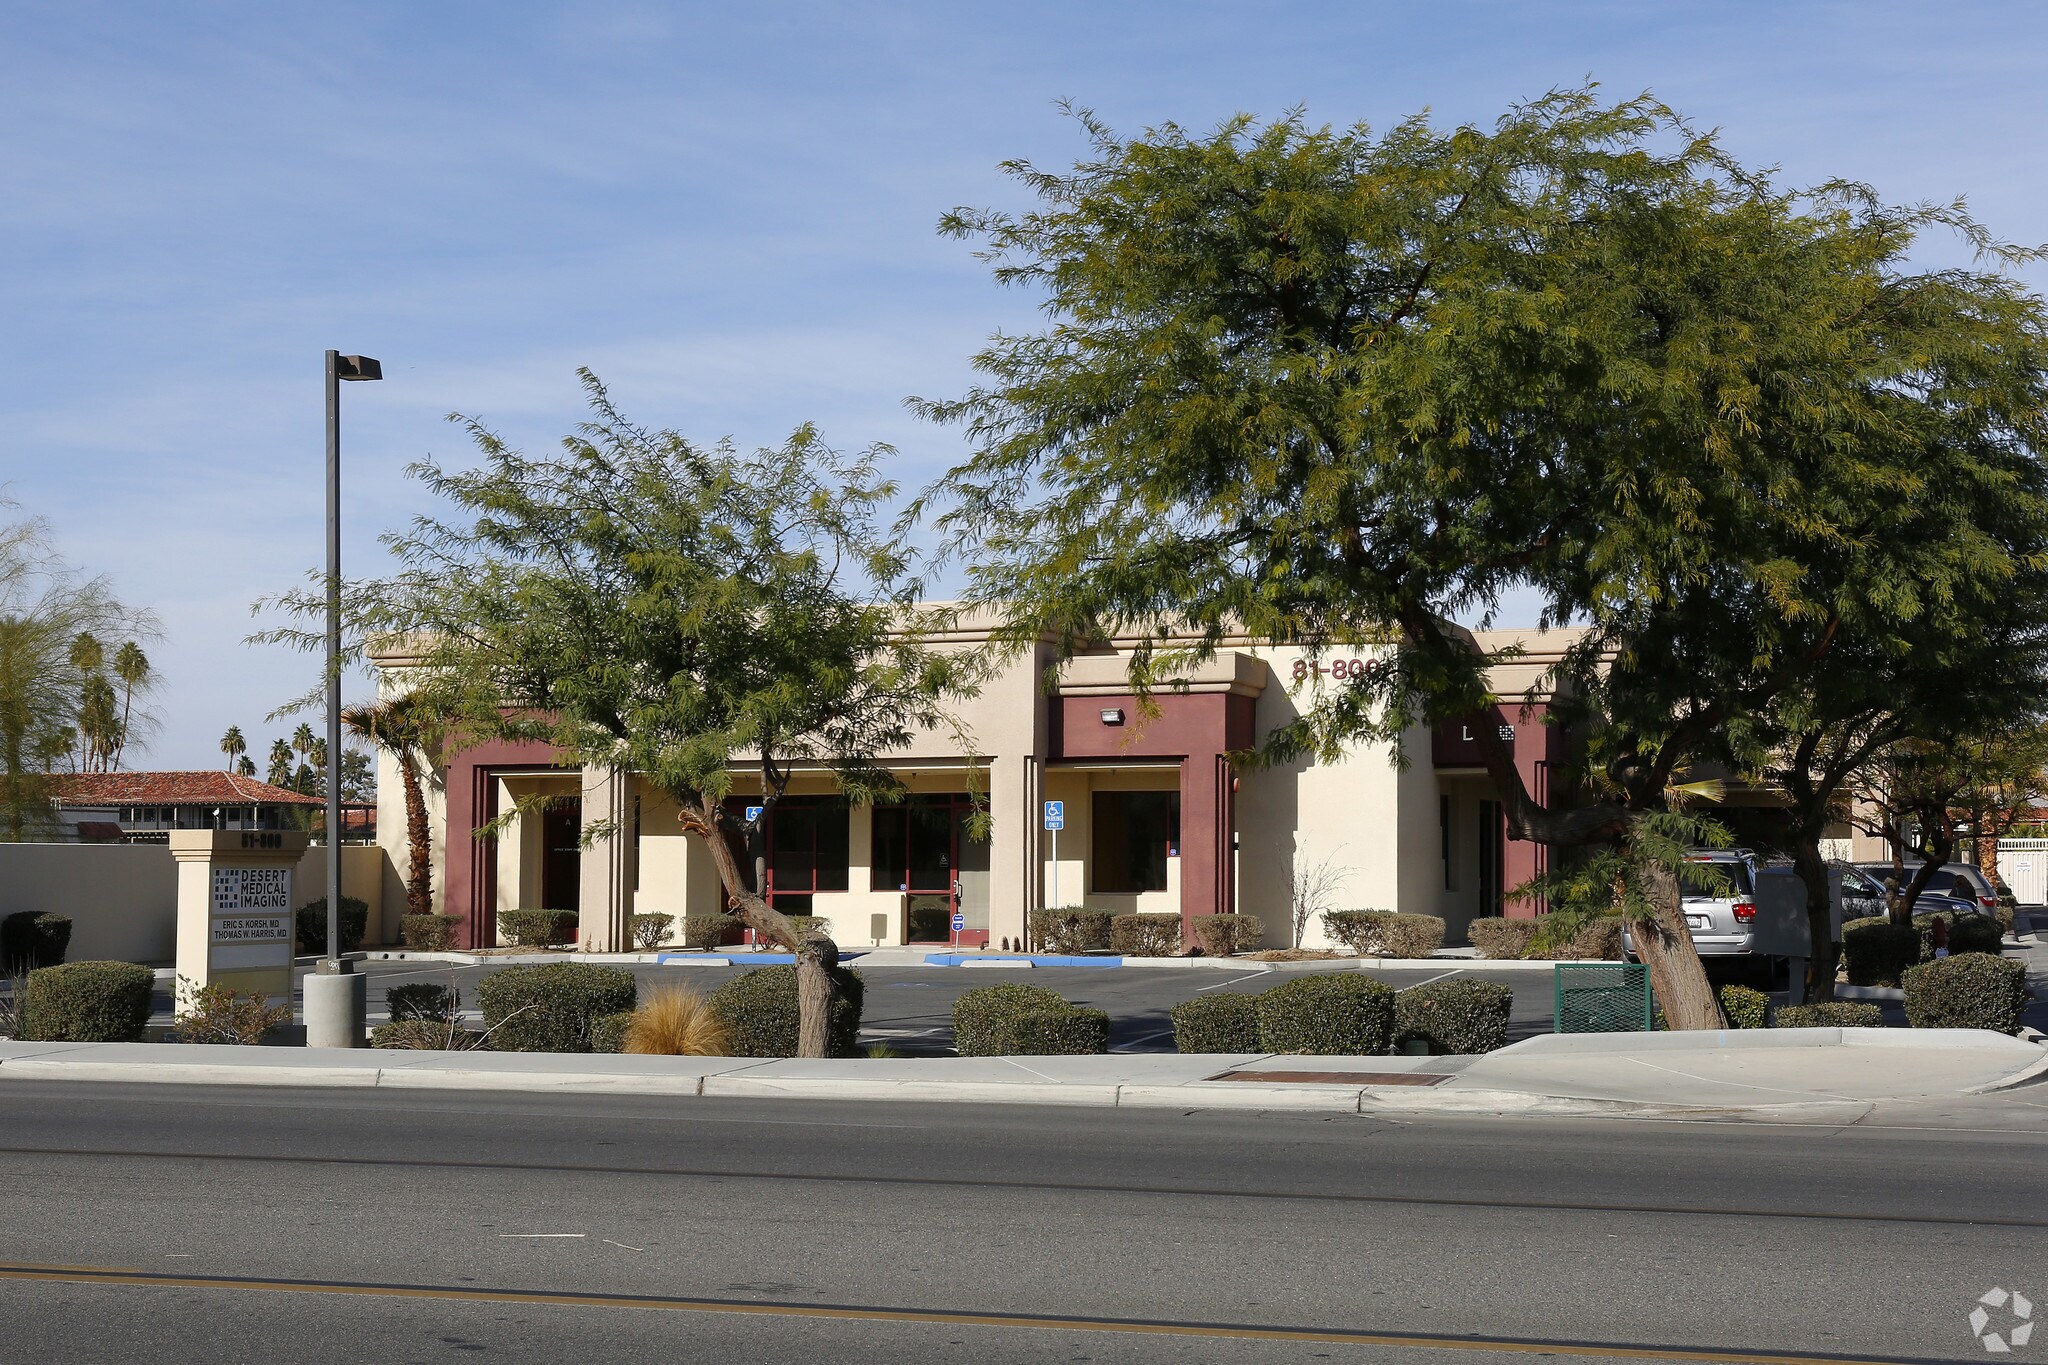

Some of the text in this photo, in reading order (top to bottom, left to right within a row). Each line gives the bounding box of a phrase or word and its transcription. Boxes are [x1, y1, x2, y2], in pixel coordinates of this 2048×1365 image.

[241, 870, 286, 882] DESERT
[241, 882, 286, 894] MEDICAL
[240, 895, 286, 908] IMAGING
[222, 919, 279, 929] ERIC S. KORSH, MD
[214, 931, 242, 940] THOMAS
[242, 930, 251, 938] W.
[251, 929, 276, 938] HARRIS,
